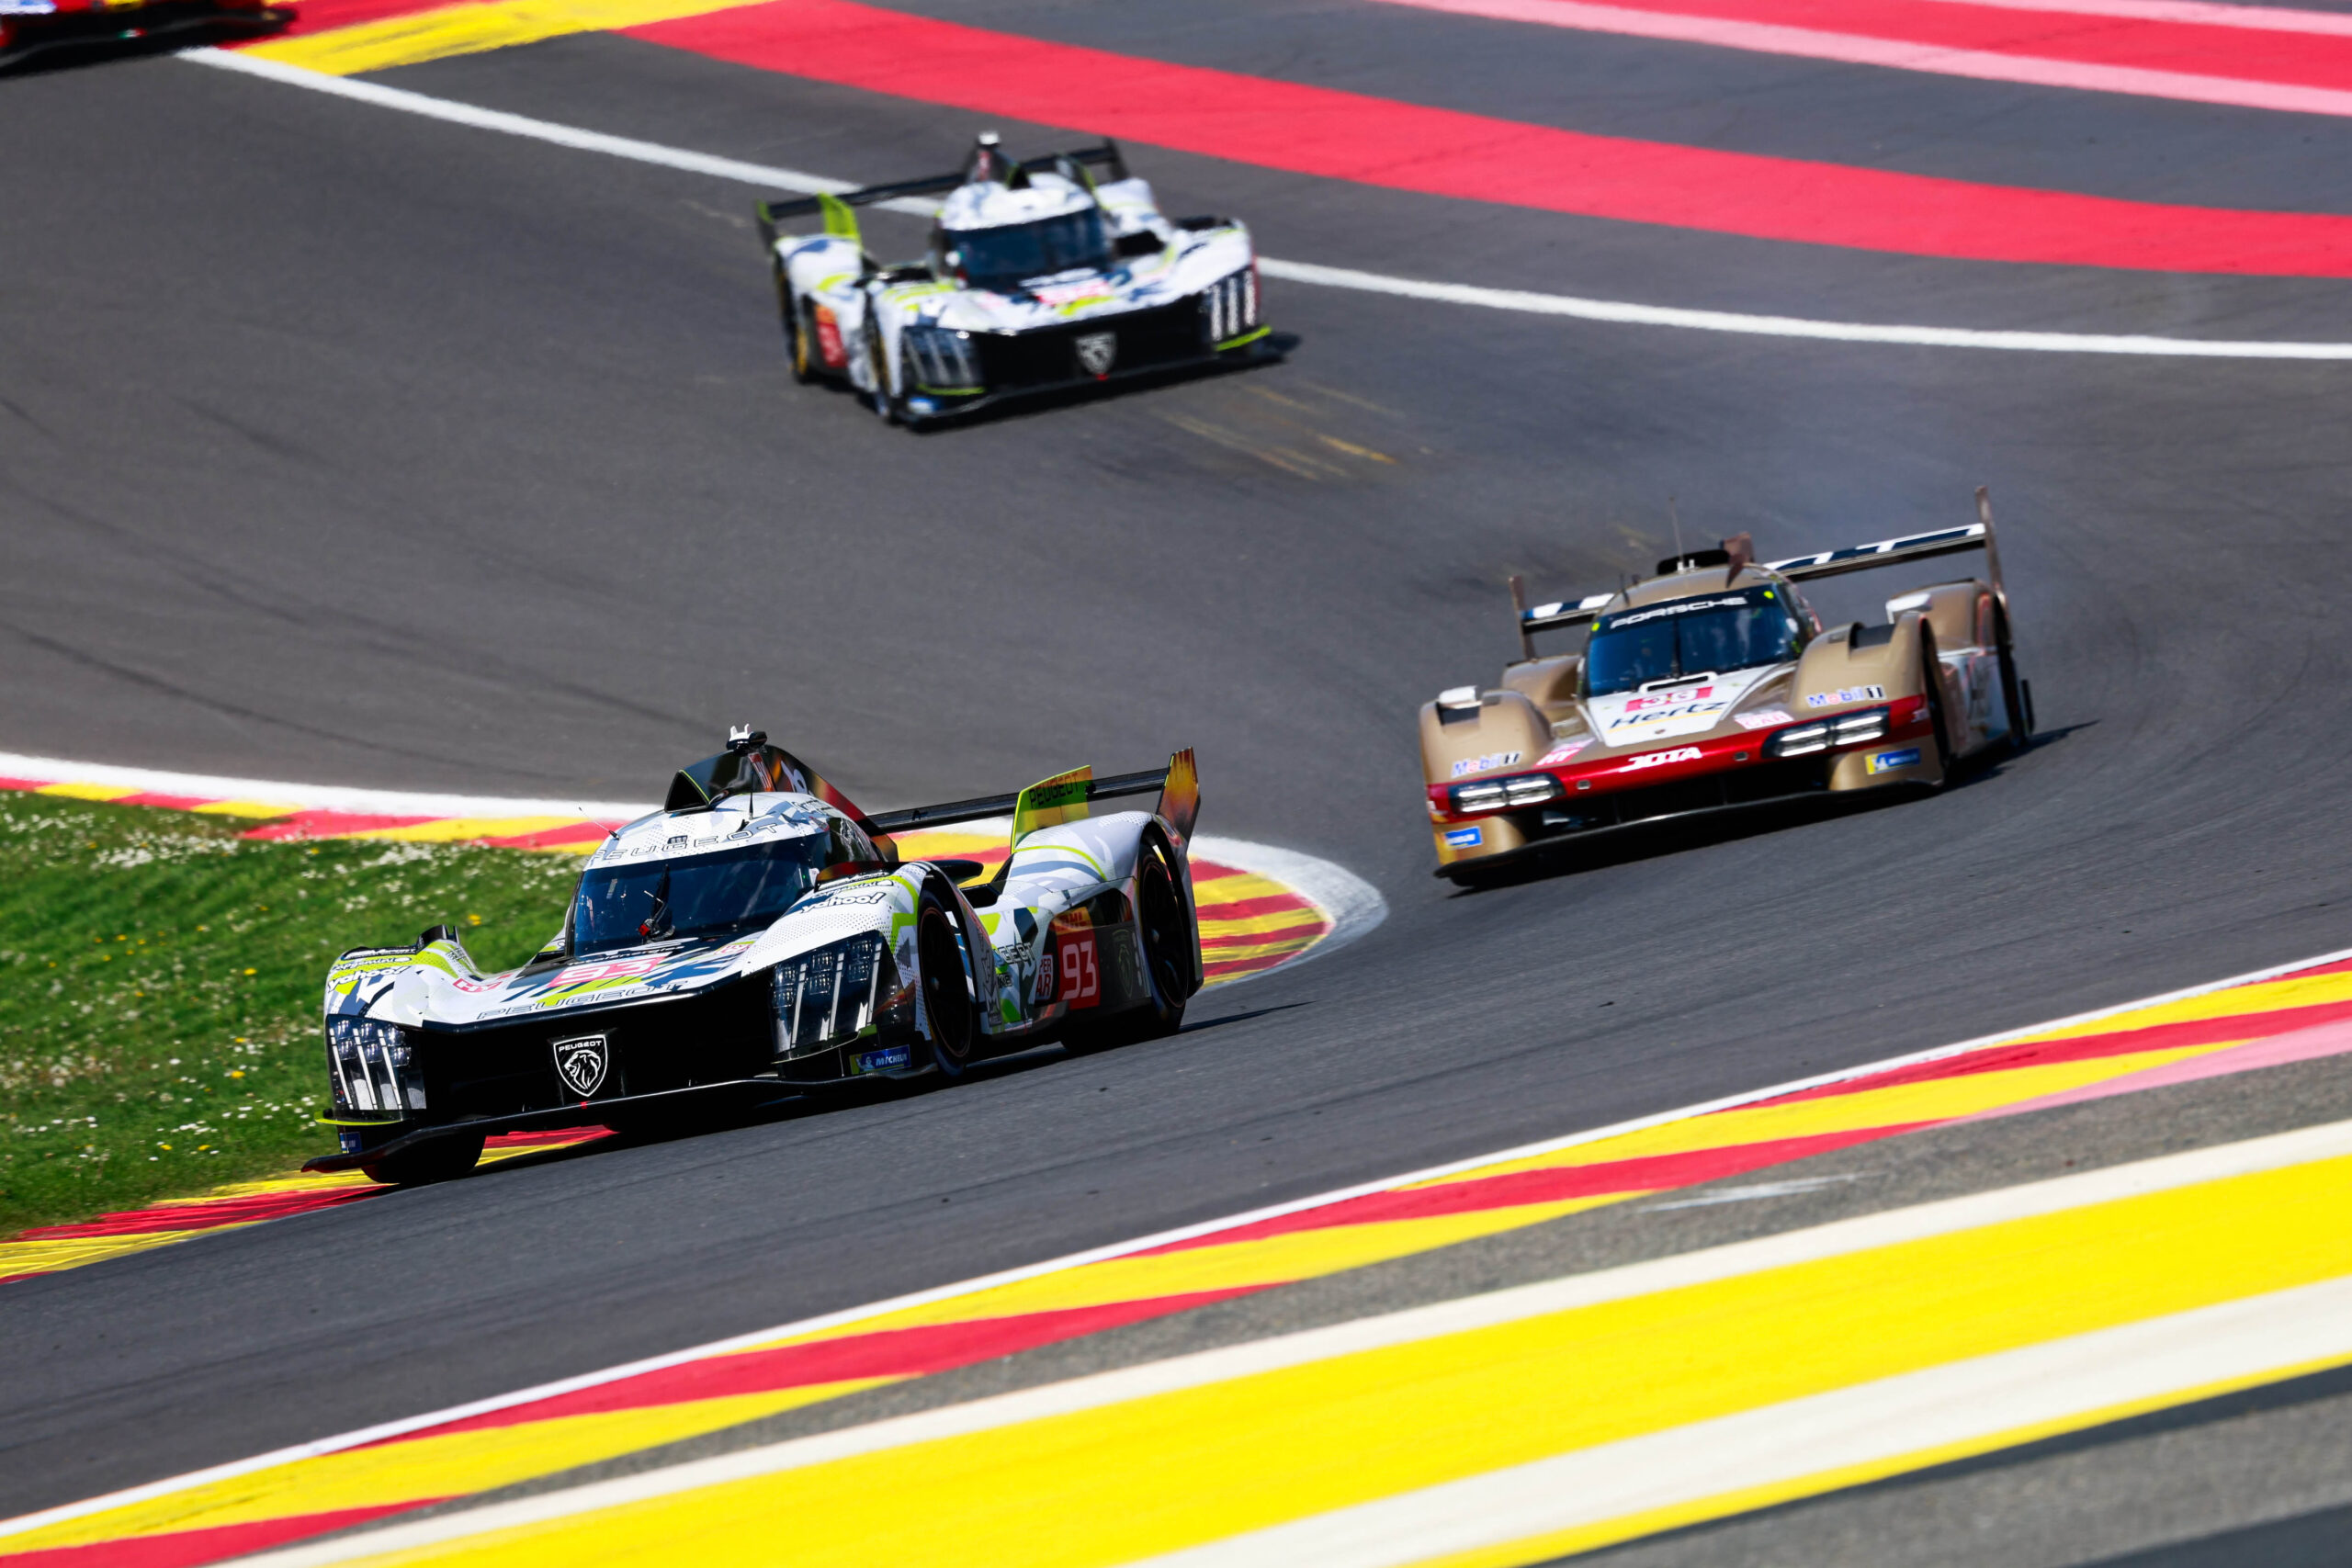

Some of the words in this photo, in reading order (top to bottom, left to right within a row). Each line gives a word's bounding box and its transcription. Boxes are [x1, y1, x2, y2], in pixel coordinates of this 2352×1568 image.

[1610, 597, 1747, 629] PORSCHE
[1808, 687, 1864, 707] Mobil
[1610, 701, 1728, 729] Hertz
[1452, 755, 1501, 777] Mobil
[1619, 747, 1702, 773] JOTA
[1029, 772, 1079, 808] PEUGEOT
[586, 823, 777, 862] PEUGEOT
[800, 892, 887, 913] yahoo!
[328, 965, 412, 993] yahoo!
[557, 957, 663, 983] 93
[1062, 940, 1097, 1000] 93
[477, 980, 688, 1020] PEUGEOT
[559, 1041, 602, 1052] PEUGEOT
